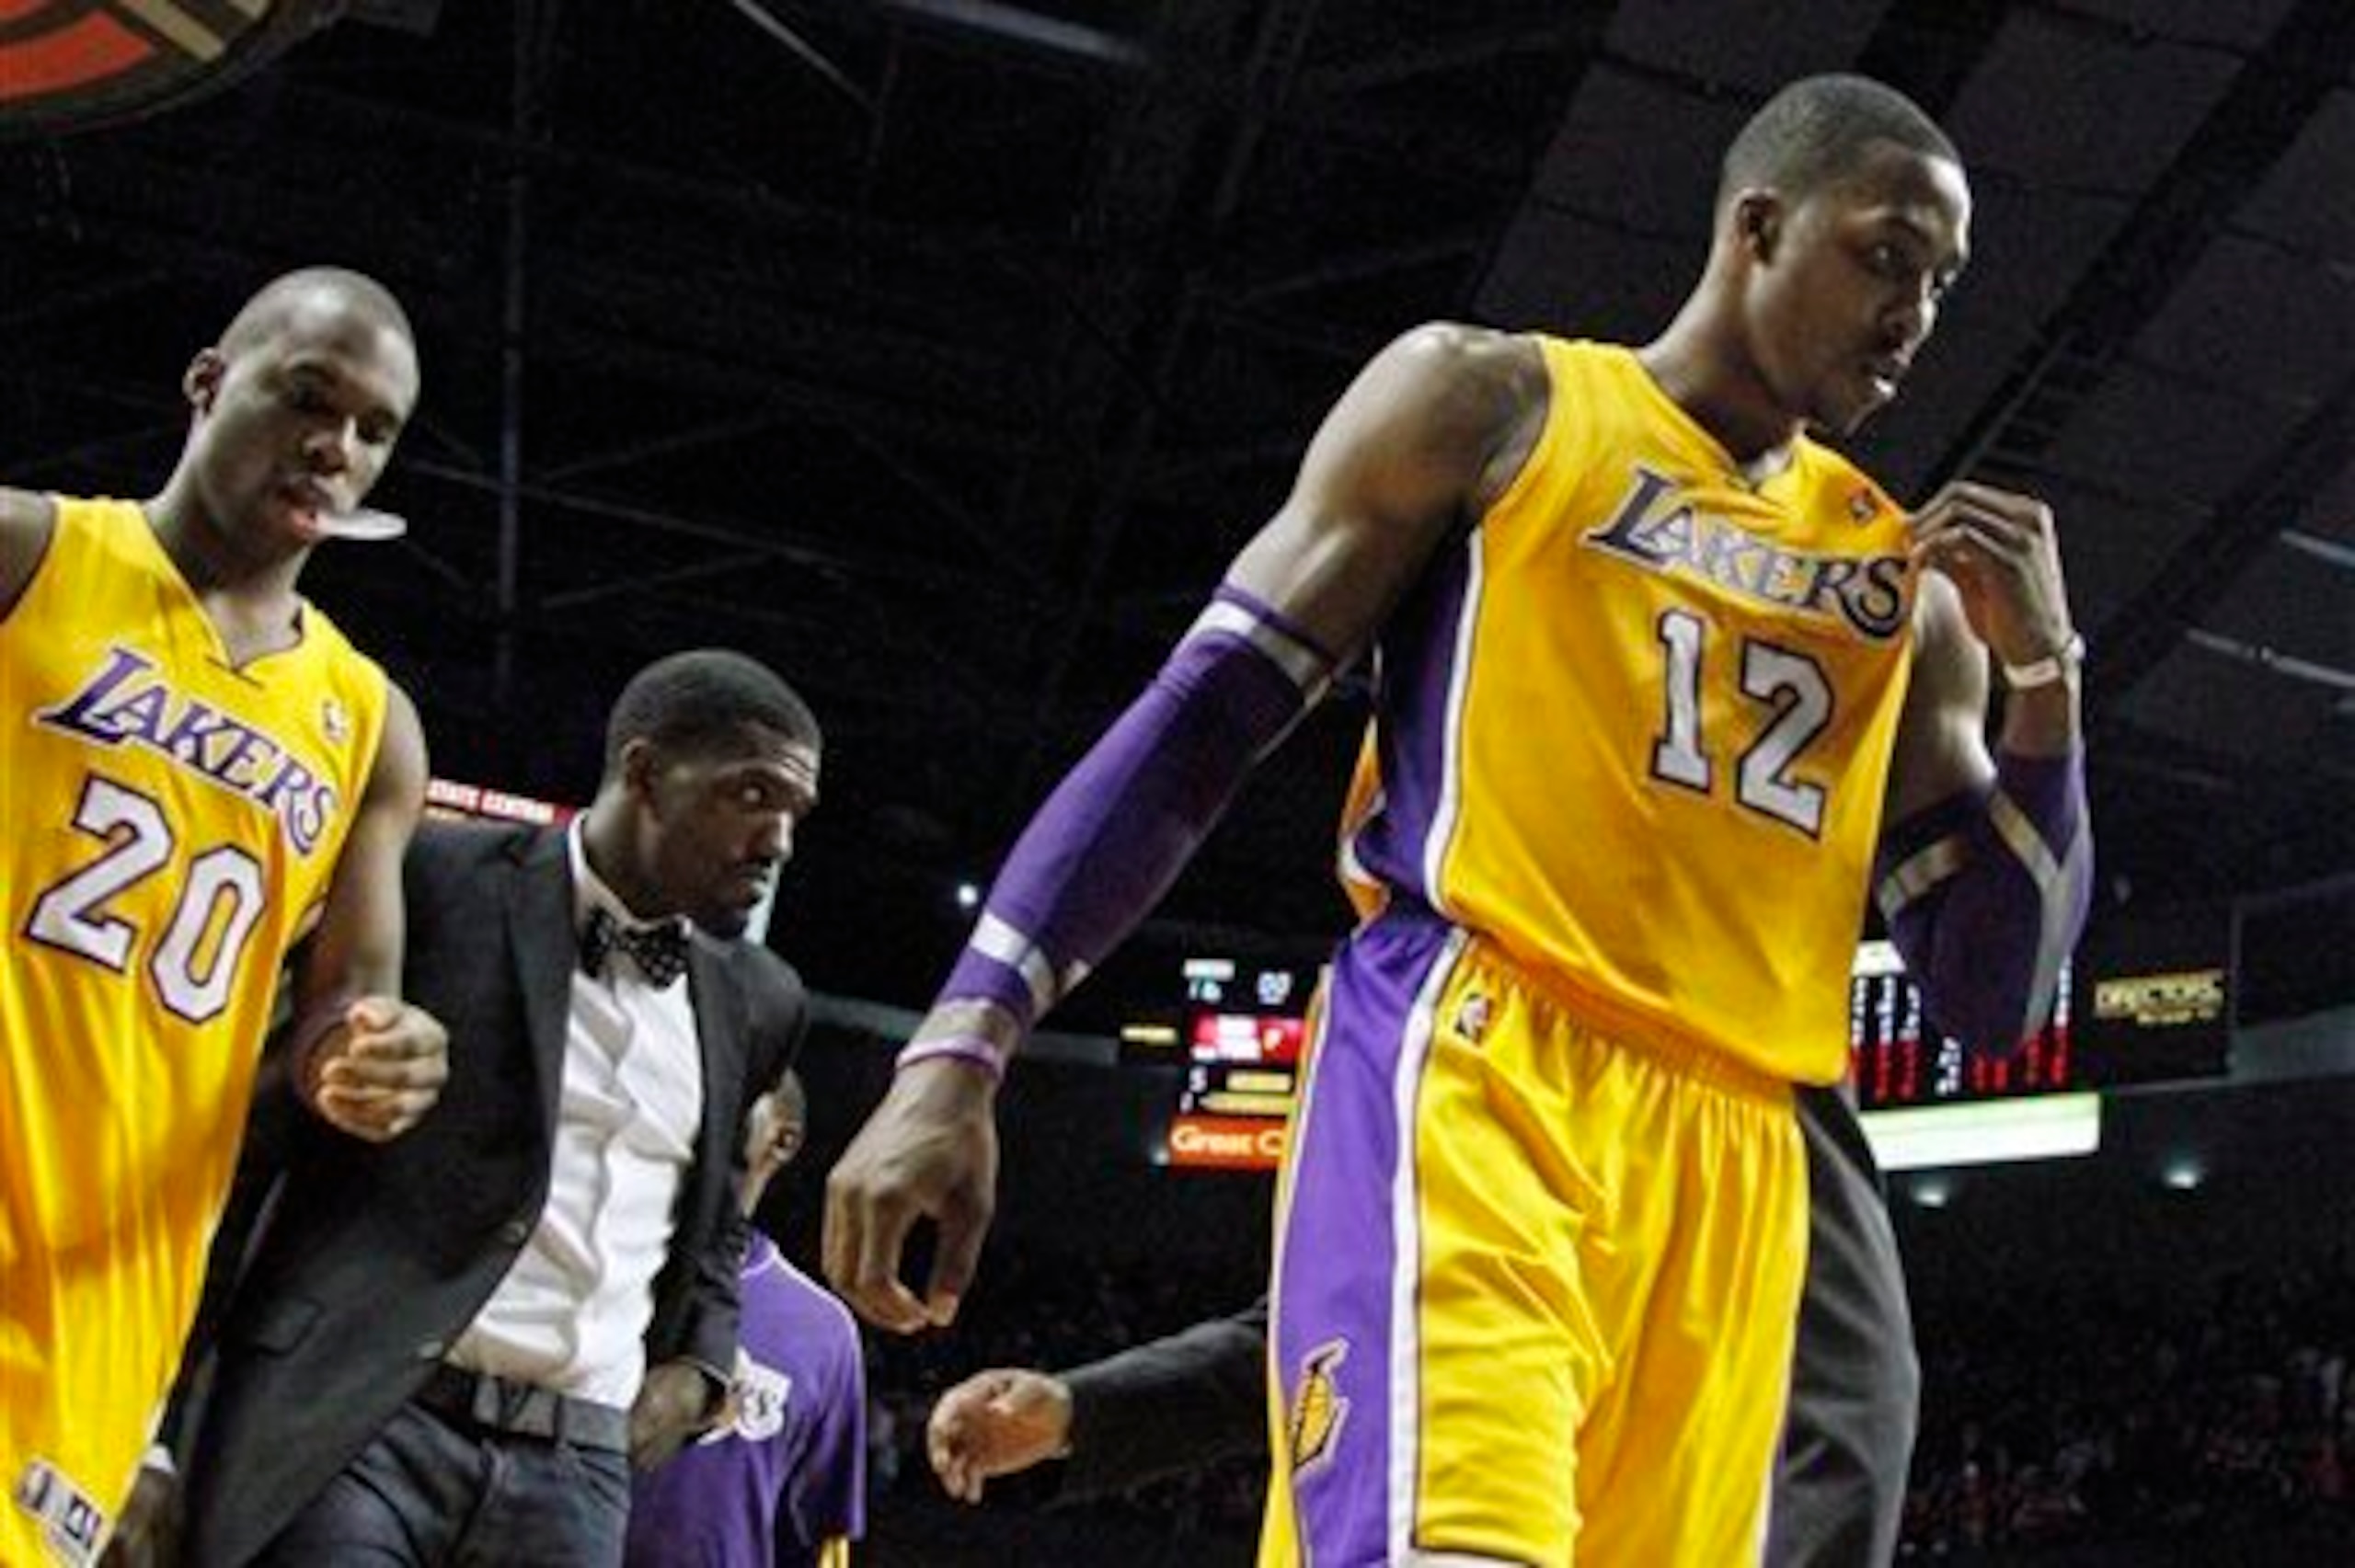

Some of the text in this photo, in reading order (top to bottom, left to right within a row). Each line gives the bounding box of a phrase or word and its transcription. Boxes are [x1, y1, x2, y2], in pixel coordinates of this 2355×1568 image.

[1580, 466, 1912, 638] LAKERS
[33, 646, 340, 857] LAKERS
[1651, 607, 1834, 841] 12
[21, 769, 267, 1025] 20
